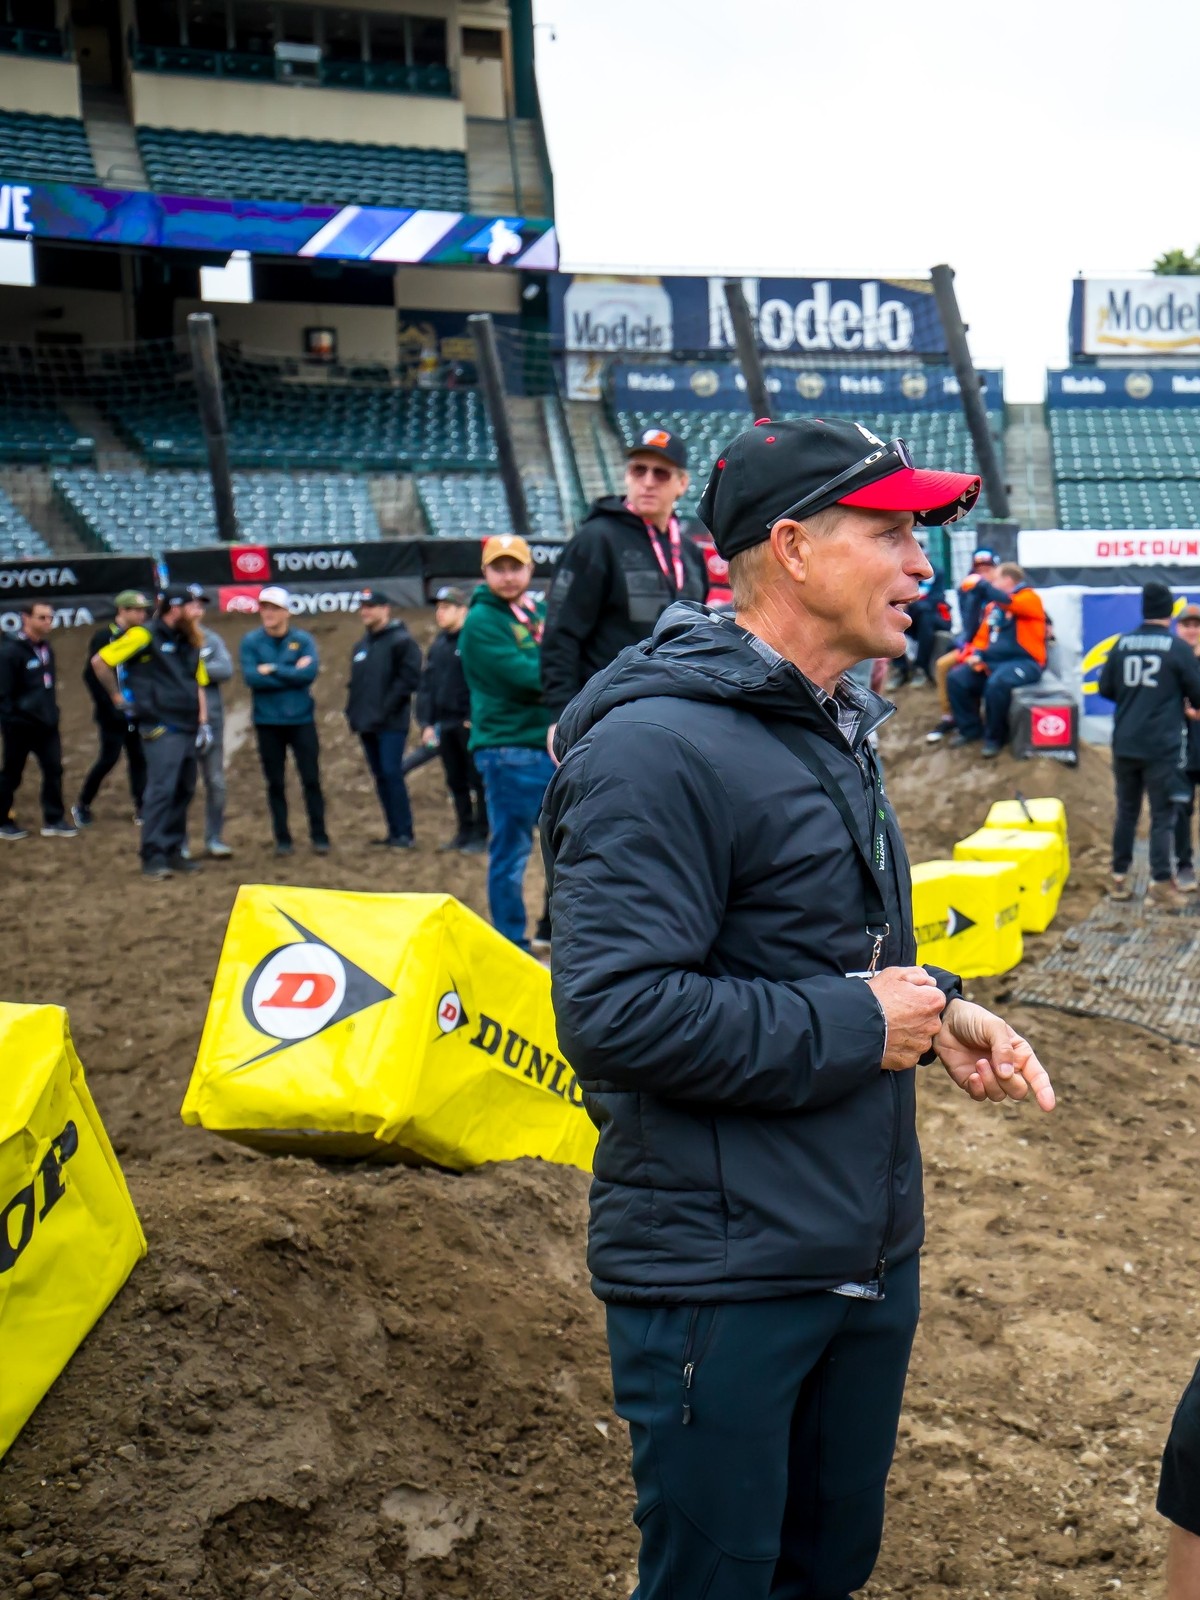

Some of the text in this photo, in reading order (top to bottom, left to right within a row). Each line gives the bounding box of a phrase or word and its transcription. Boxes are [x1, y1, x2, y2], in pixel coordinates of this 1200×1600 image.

[273, 550, 358, 571] TOYOTA
[0, 566, 77, 589] OYOTA
[1123, 655, 1162, 688] 02
[259, 972, 337, 1010] D
[469, 1012, 585, 1108] DUNLO
